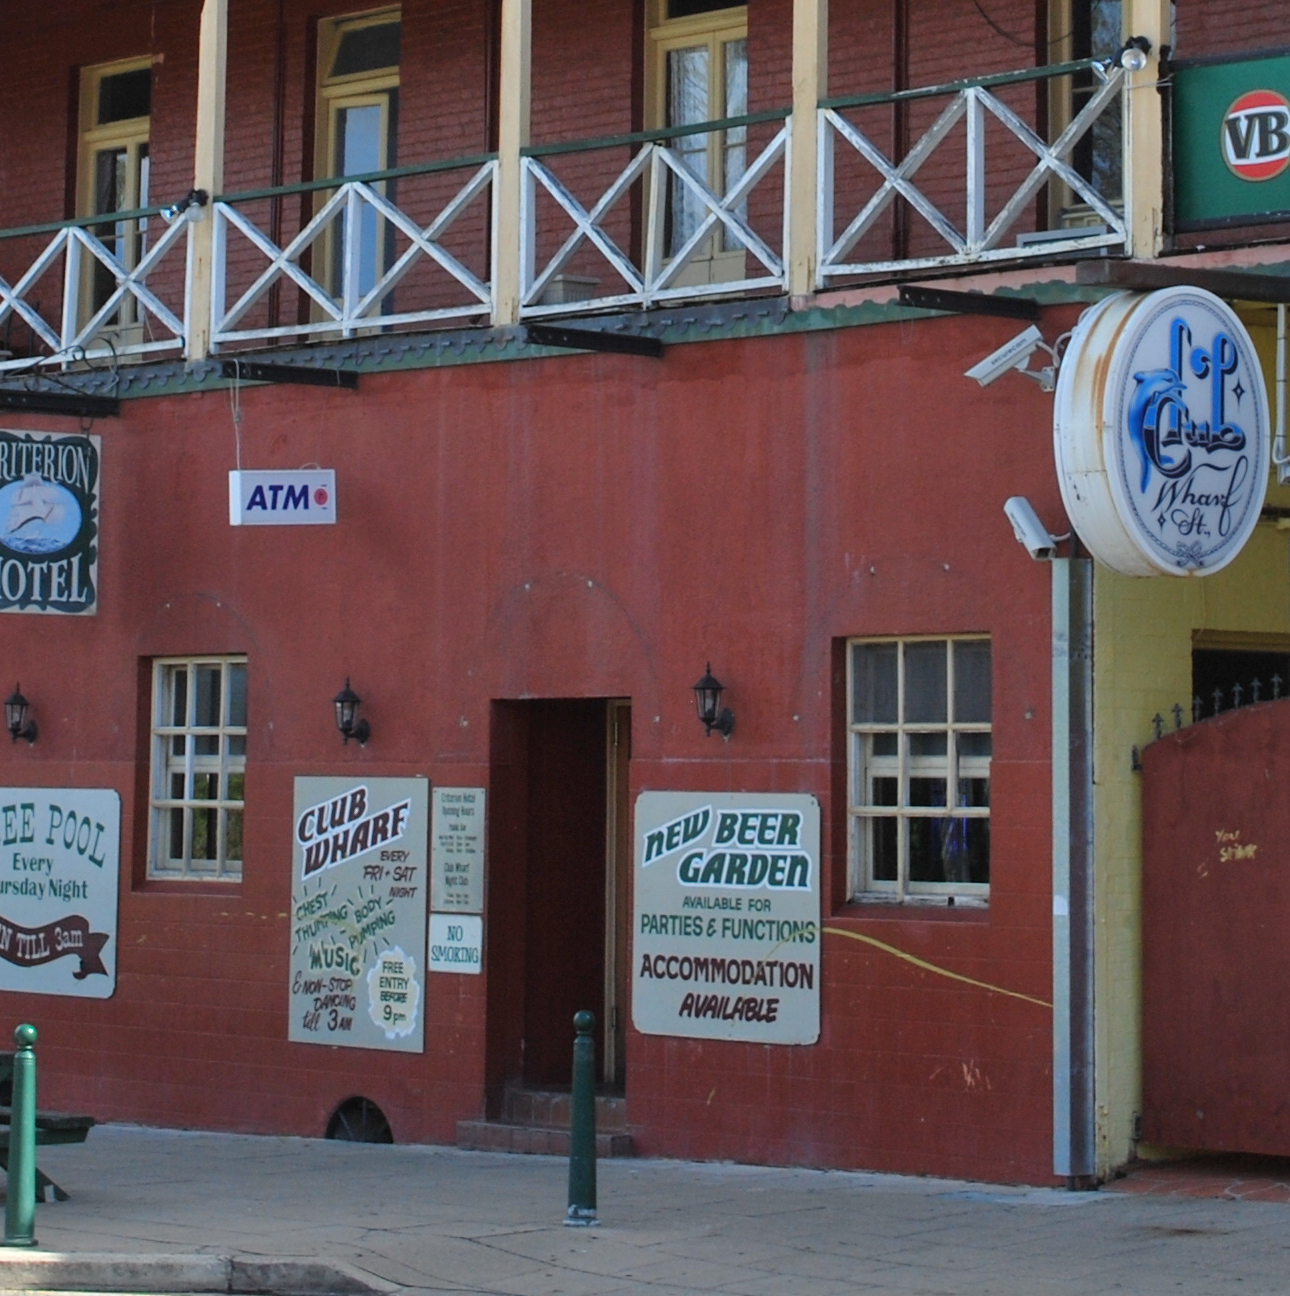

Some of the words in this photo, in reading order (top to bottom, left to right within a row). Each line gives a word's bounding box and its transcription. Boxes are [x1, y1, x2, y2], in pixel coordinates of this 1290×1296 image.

[1225, 111, 1290, 159] VB
[246, 484, 309, 510] ATM
[1152, 455, 1248, 537] Wharf
[298, 788, 367, 842] CLUB
[45, 803, 107, 869] POOL
[304, 802, 409, 876] WHARF
[644, 807, 711, 864] NEW
[714, 812, 801, 846] BEER
[12, 852, 53, 876] Every
[380, 850, 410, 863] EVERY
[363, 865, 384, 882] FRI
[393, 865, 418, 883] SAT
[678, 852, 810, 888] GARDEN
[48, 879, 89, 902] Night
[389, 886, 418, 899] NIGHT
[296, 891, 328, 921] CHEST
[354, 896, 383, 923] BODY
[682, 896, 742, 911] AVAILABLE
[748, 898, 772, 912] FOR
[447, 925, 464, 942] NO
[640, 913, 704, 937] PARTIES
[721, 918, 816, 944] FUNCTIONS
[16, 932, 51, 960] TILL
[54, 926, 84, 951] 3am
[431, 945, 479, 963] SMOKING
[310, 946, 361, 977] MUSIC
[382, 960, 404, 974] FREE
[640, 953, 814, 990] ACCOMMODATION
[302, 976, 354, 995] NON-STOP
[379, 976, 410, 990] ENTRY
[314, 994, 357, 1012] DANCING
[380, 990, 409, 1004] BEFORE
[678, 992, 780, 1024] AVAILABLE
